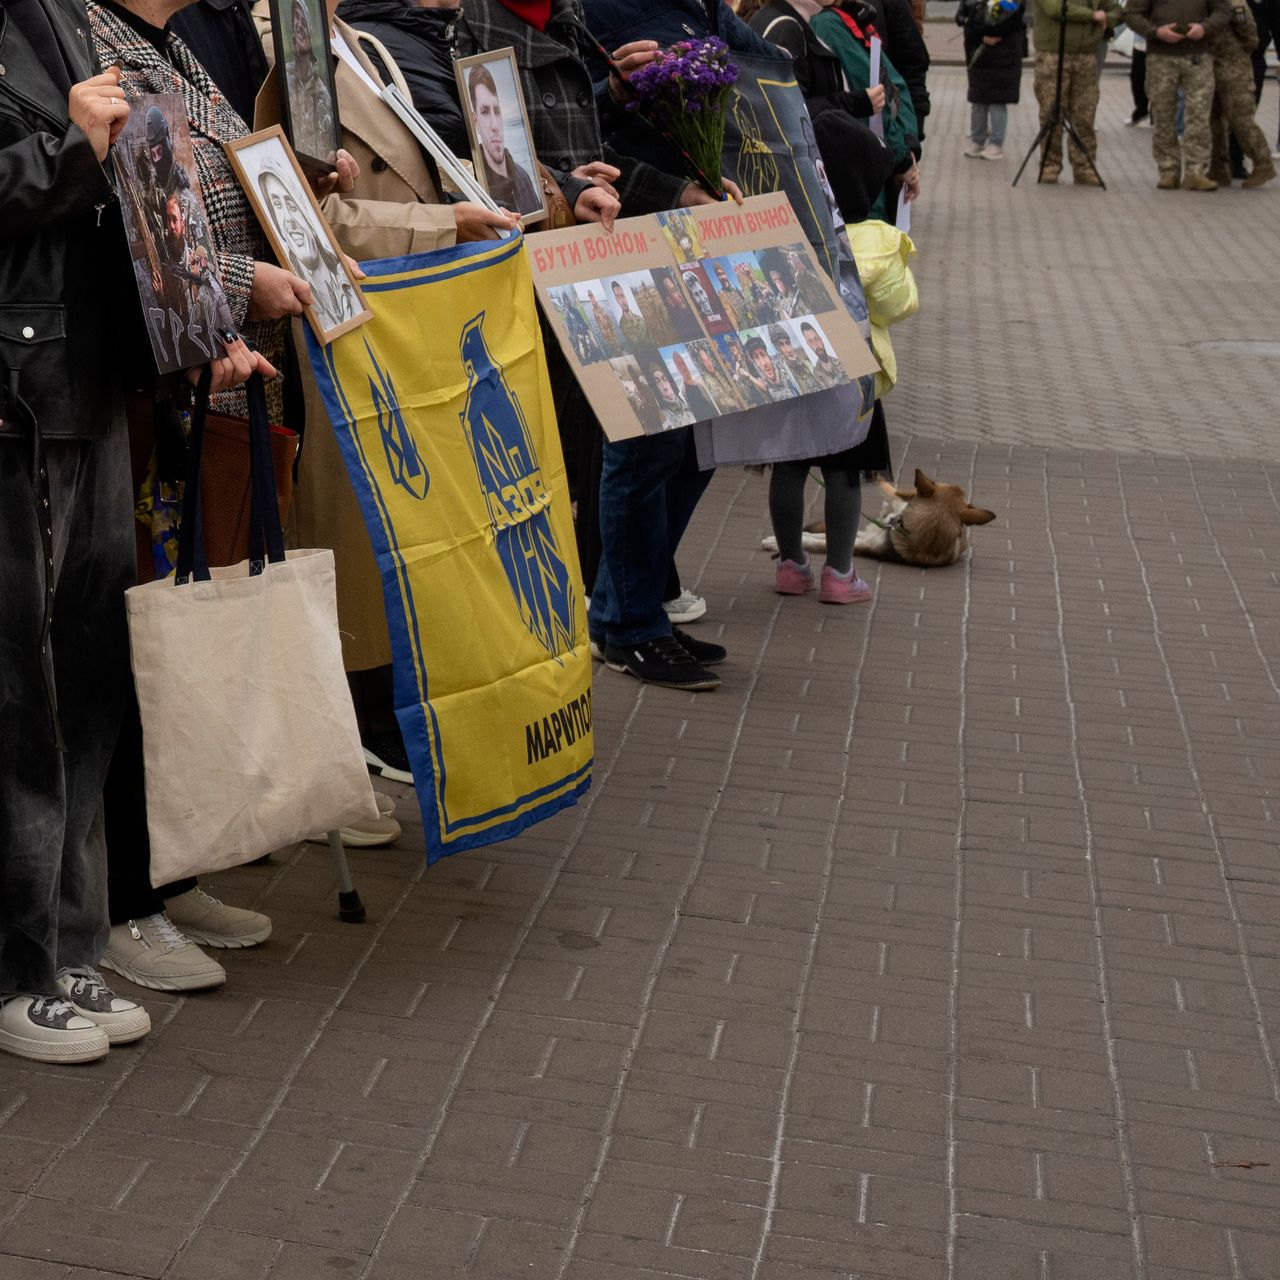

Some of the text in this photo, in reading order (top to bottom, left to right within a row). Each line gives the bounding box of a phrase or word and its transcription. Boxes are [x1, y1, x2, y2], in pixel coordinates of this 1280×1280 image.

[533, 243, 582, 273] БУТИ
[699, 217, 744, 242] ЖИТИ
[748, 202, 798, 232] ВІЧНО!
[488, 477, 552, 531] АЗОВ
